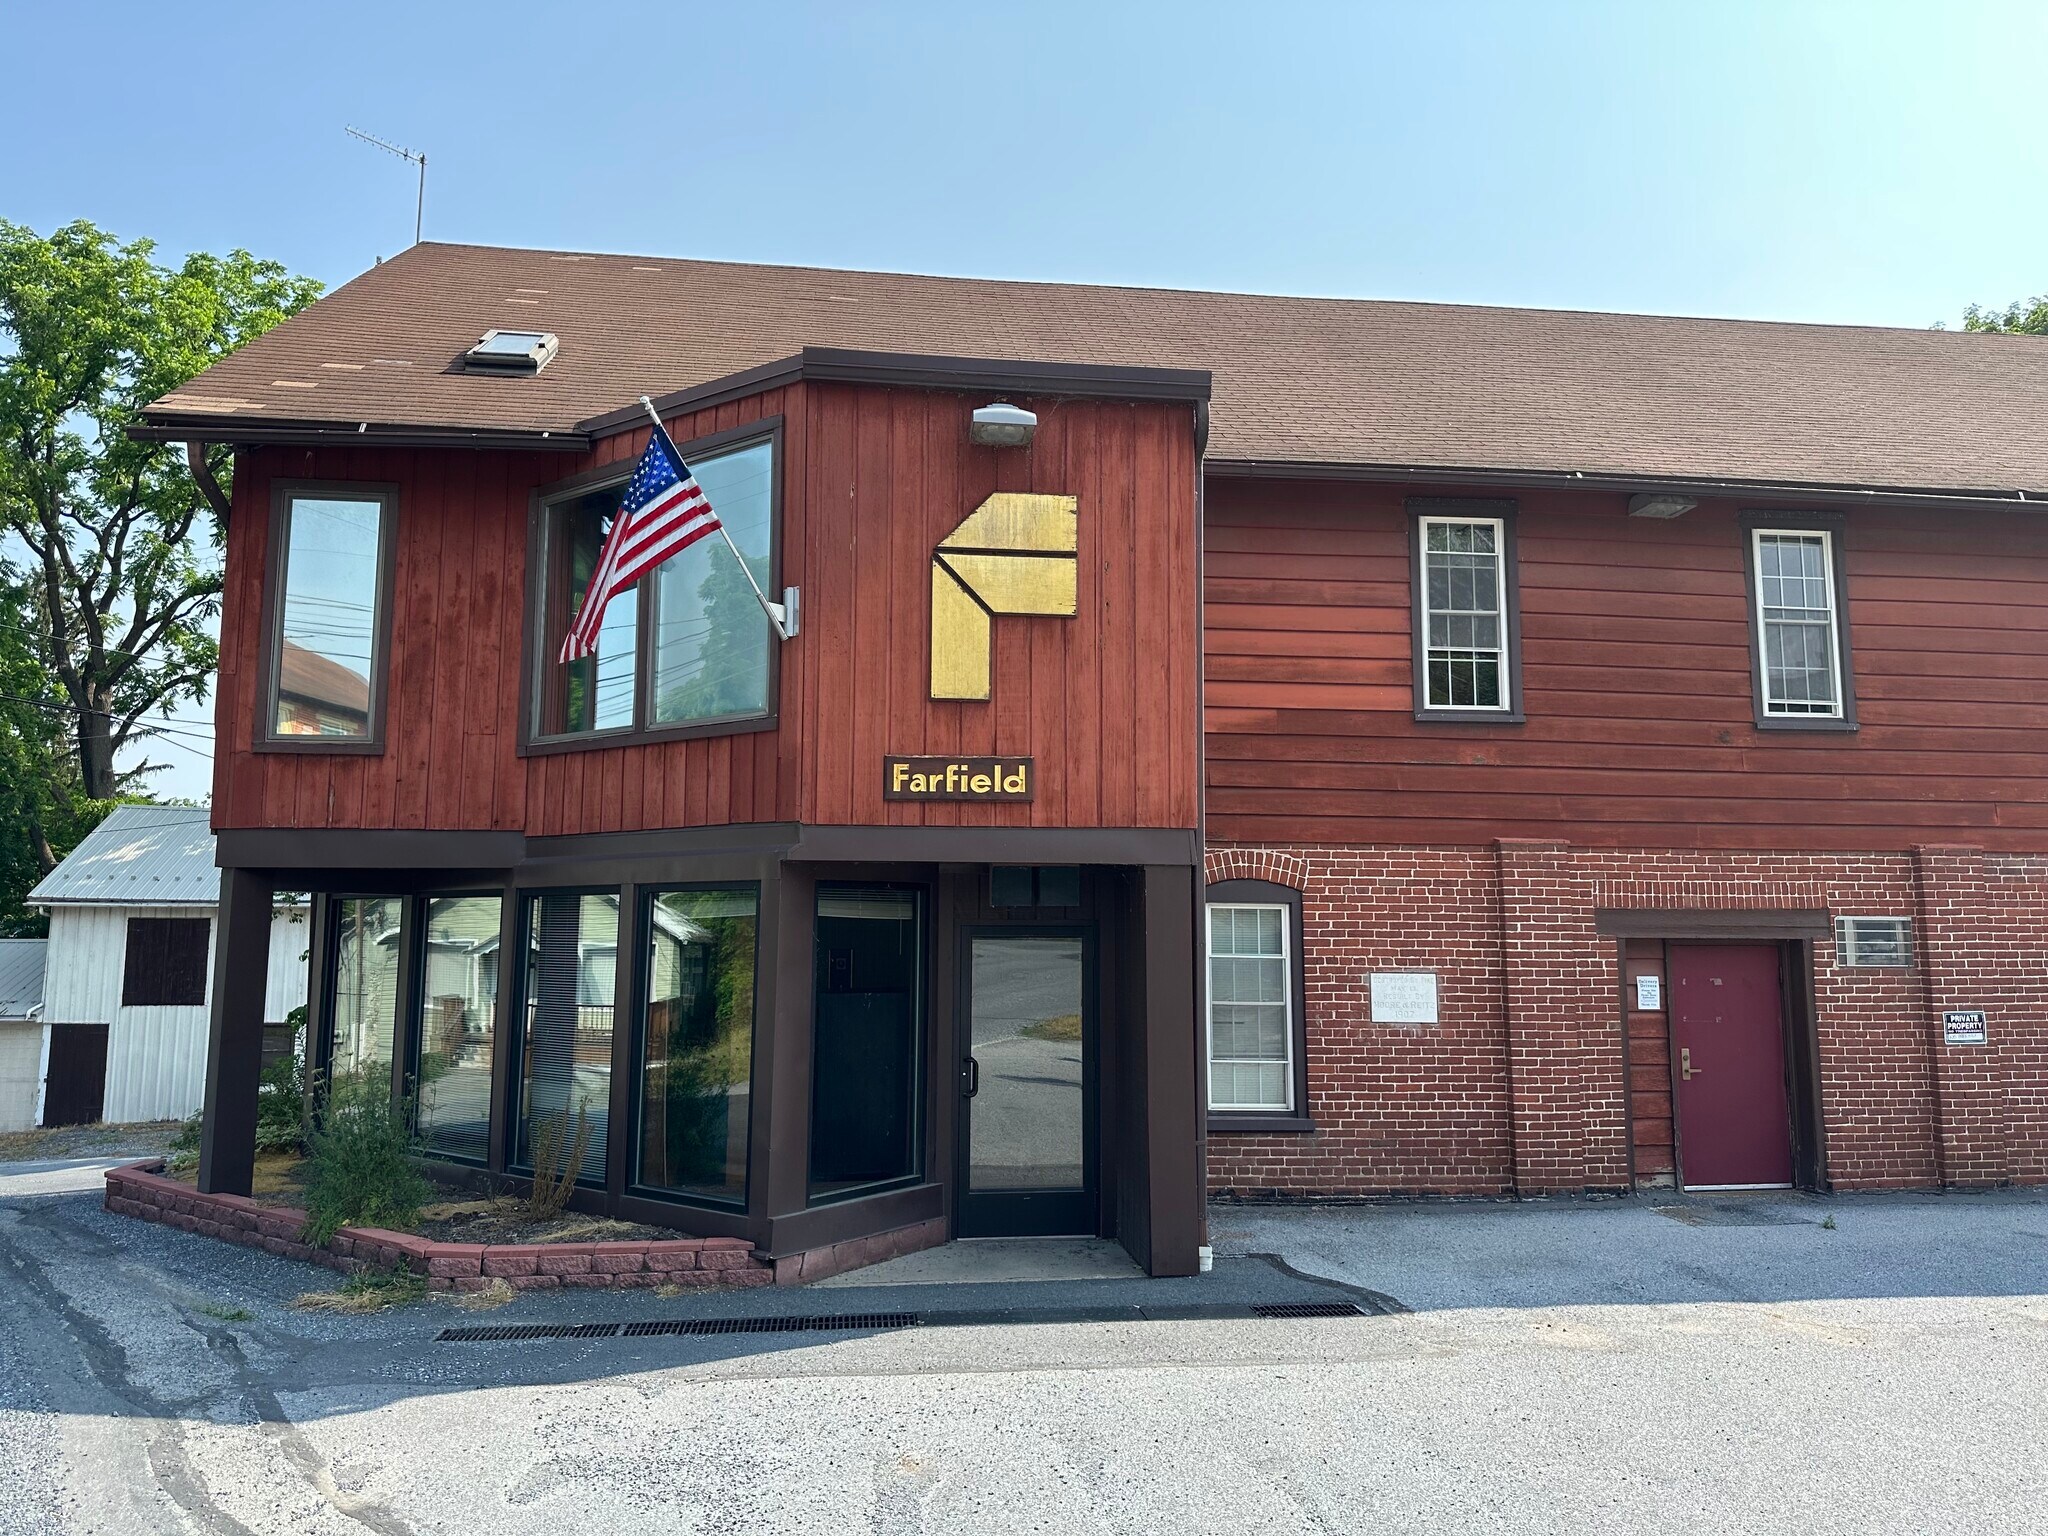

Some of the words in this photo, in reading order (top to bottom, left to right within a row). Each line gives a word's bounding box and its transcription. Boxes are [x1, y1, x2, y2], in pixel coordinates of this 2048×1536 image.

[892, 763, 1026, 793] Farfield
[1373, 1001, 1400, 1009] MOORE
[1947, 1022, 1982, 1030] PROPERTY
